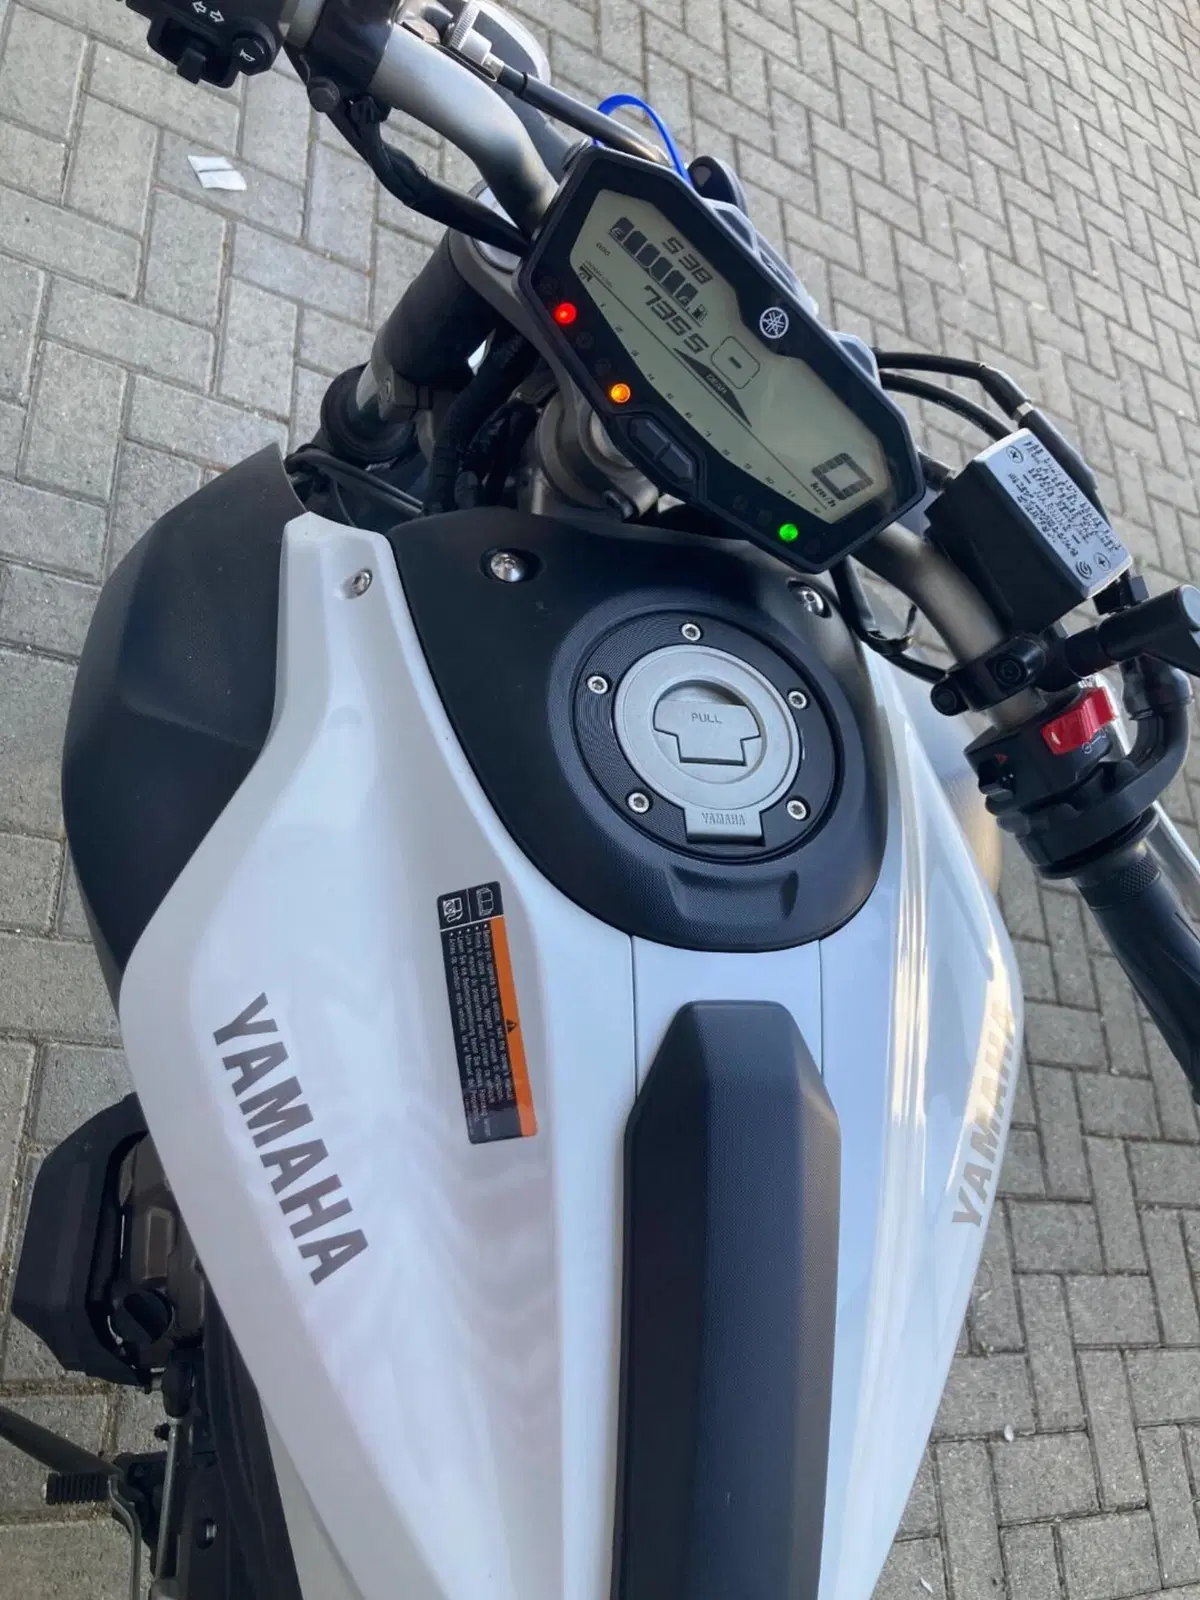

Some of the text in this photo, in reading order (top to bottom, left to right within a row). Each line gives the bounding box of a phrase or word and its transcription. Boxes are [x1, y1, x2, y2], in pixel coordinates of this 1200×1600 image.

[810, 481, 836, 508] km/h
[691, 712, 722, 725] PULL
[701, 812, 746, 826] YAMAHA
[951, 1001, 1015, 1228] YAMAHA
[212, 991, 369, 1286] YAMAHA
